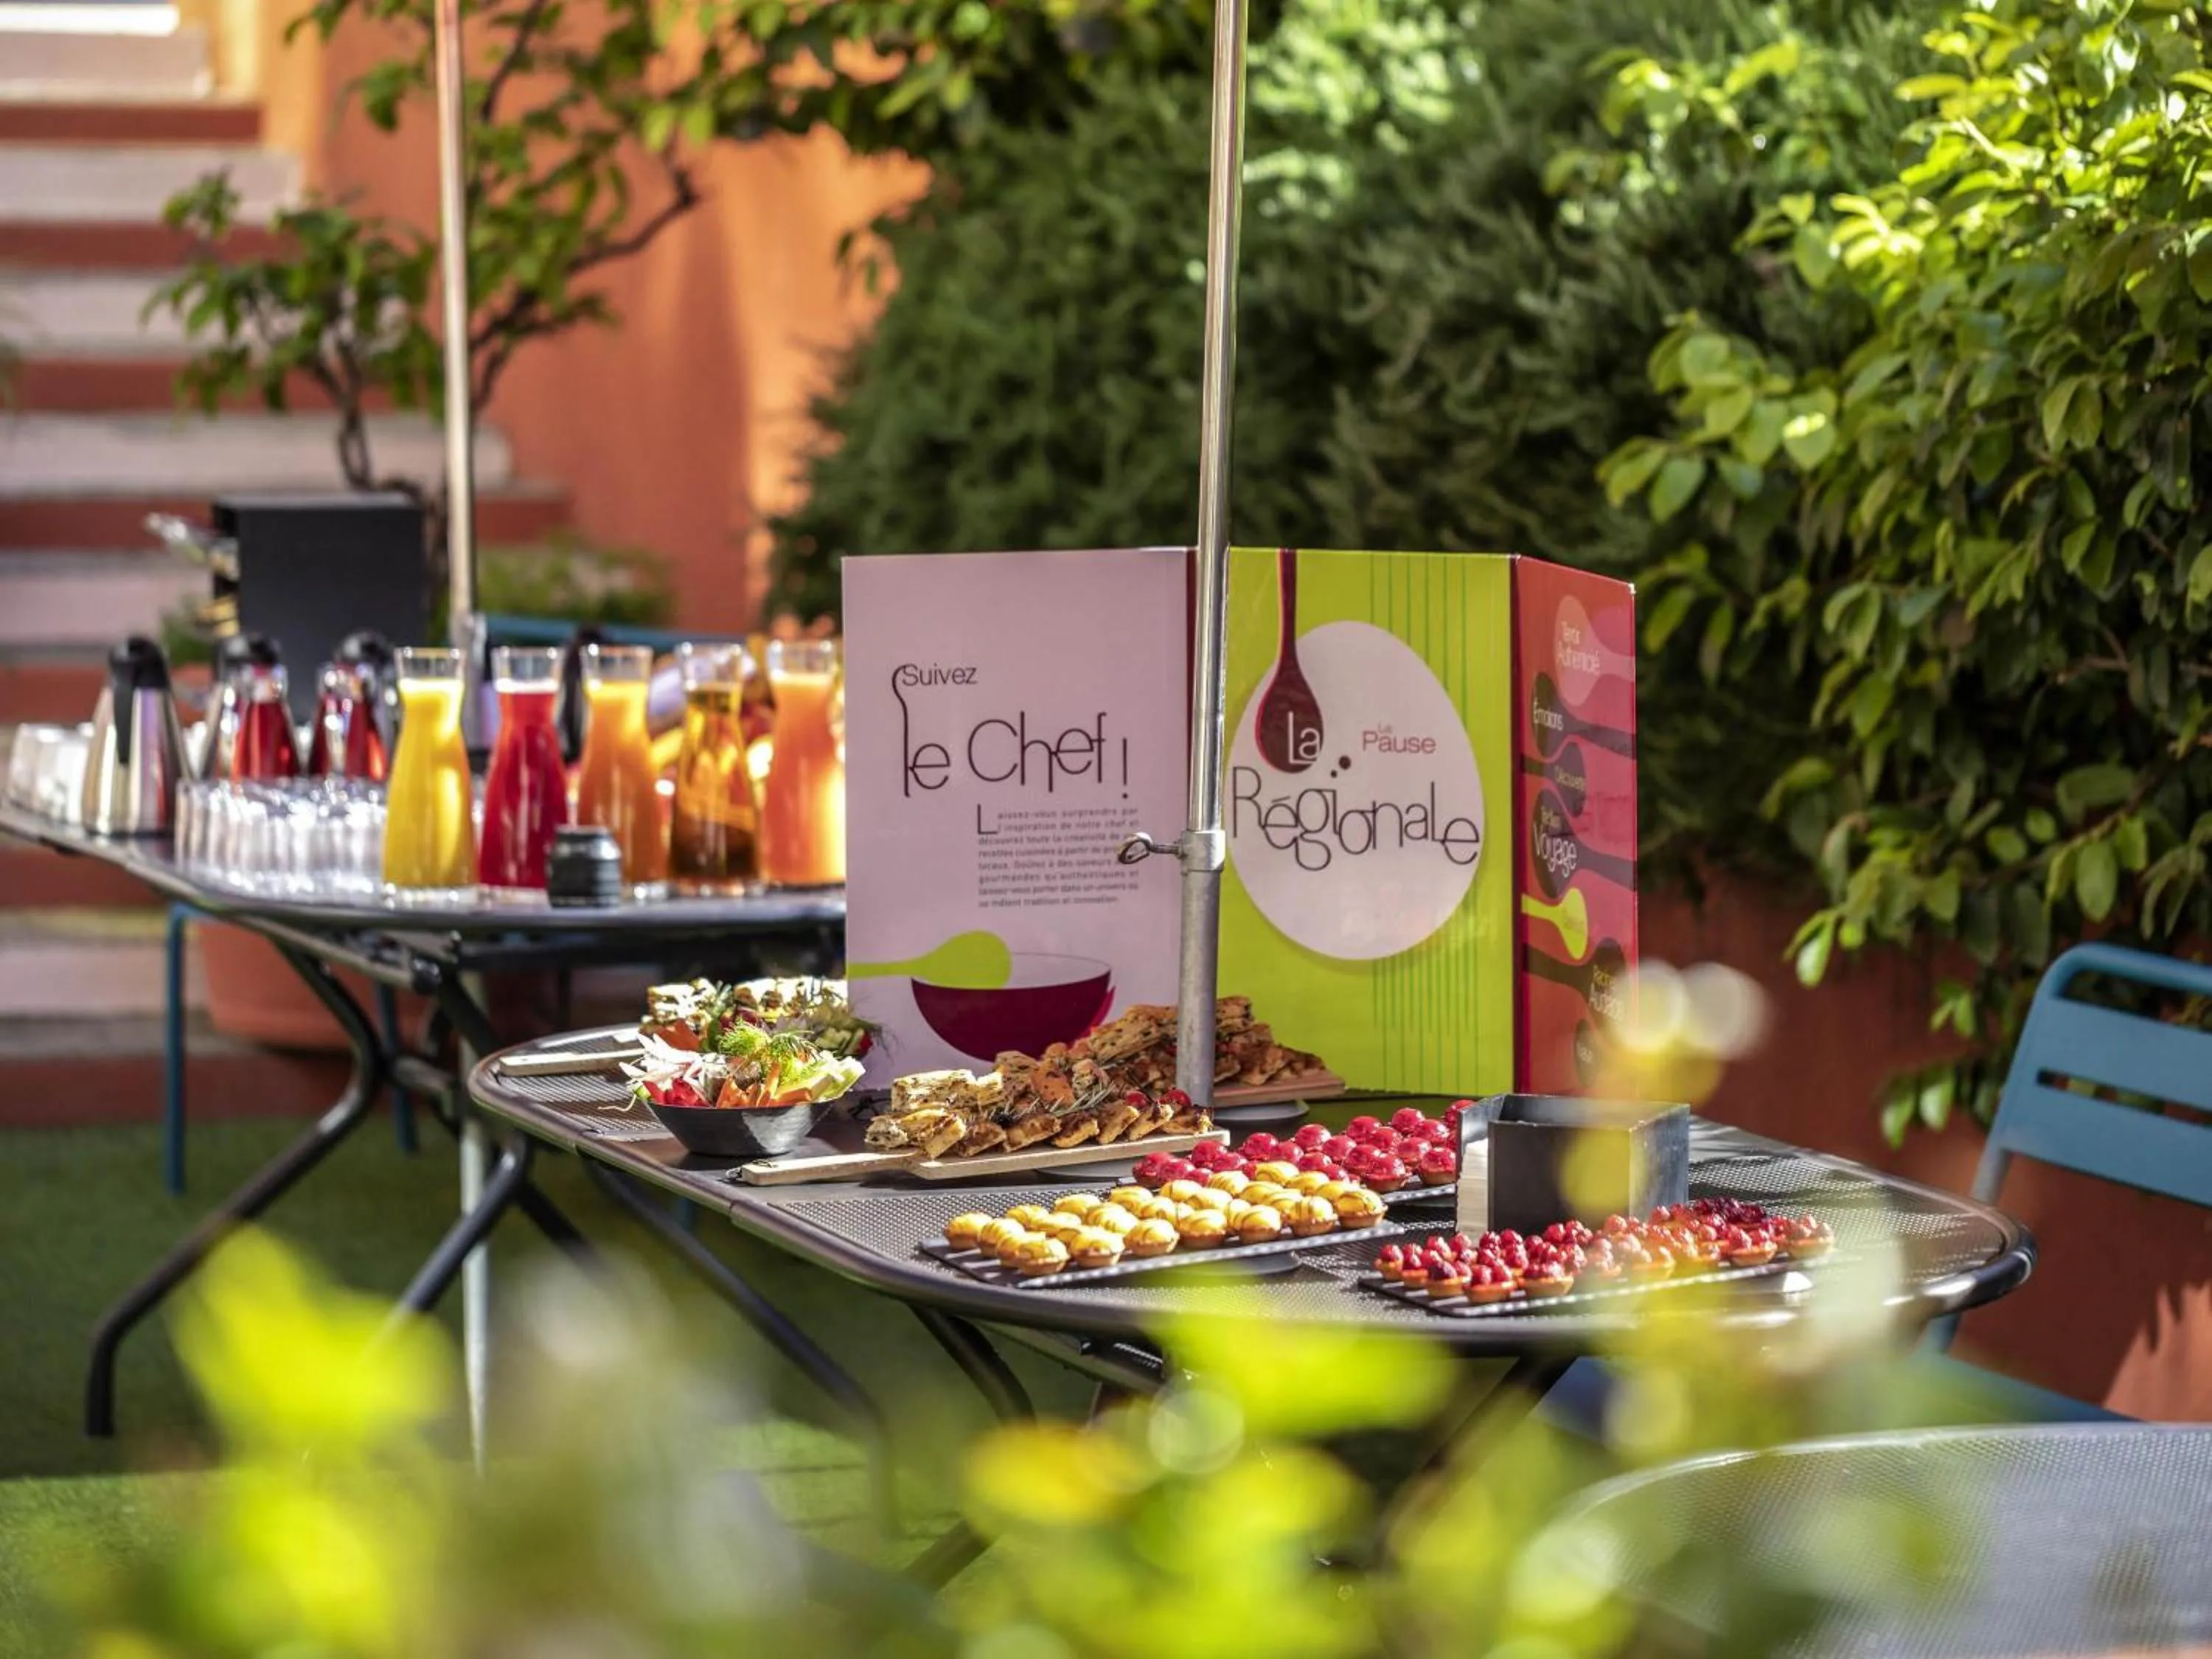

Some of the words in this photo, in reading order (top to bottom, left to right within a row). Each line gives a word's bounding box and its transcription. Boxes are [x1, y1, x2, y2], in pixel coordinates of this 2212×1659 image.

[902, 662, 978, 686] Suivez
[892, 664, 950, 797] le
[1287, 710, 1321, 765] La
[1362, 730, 1437, 754] Pause
[1233, 765, 1481, 872] Régionale
[1533, 822, 1577, 879] Voyage
